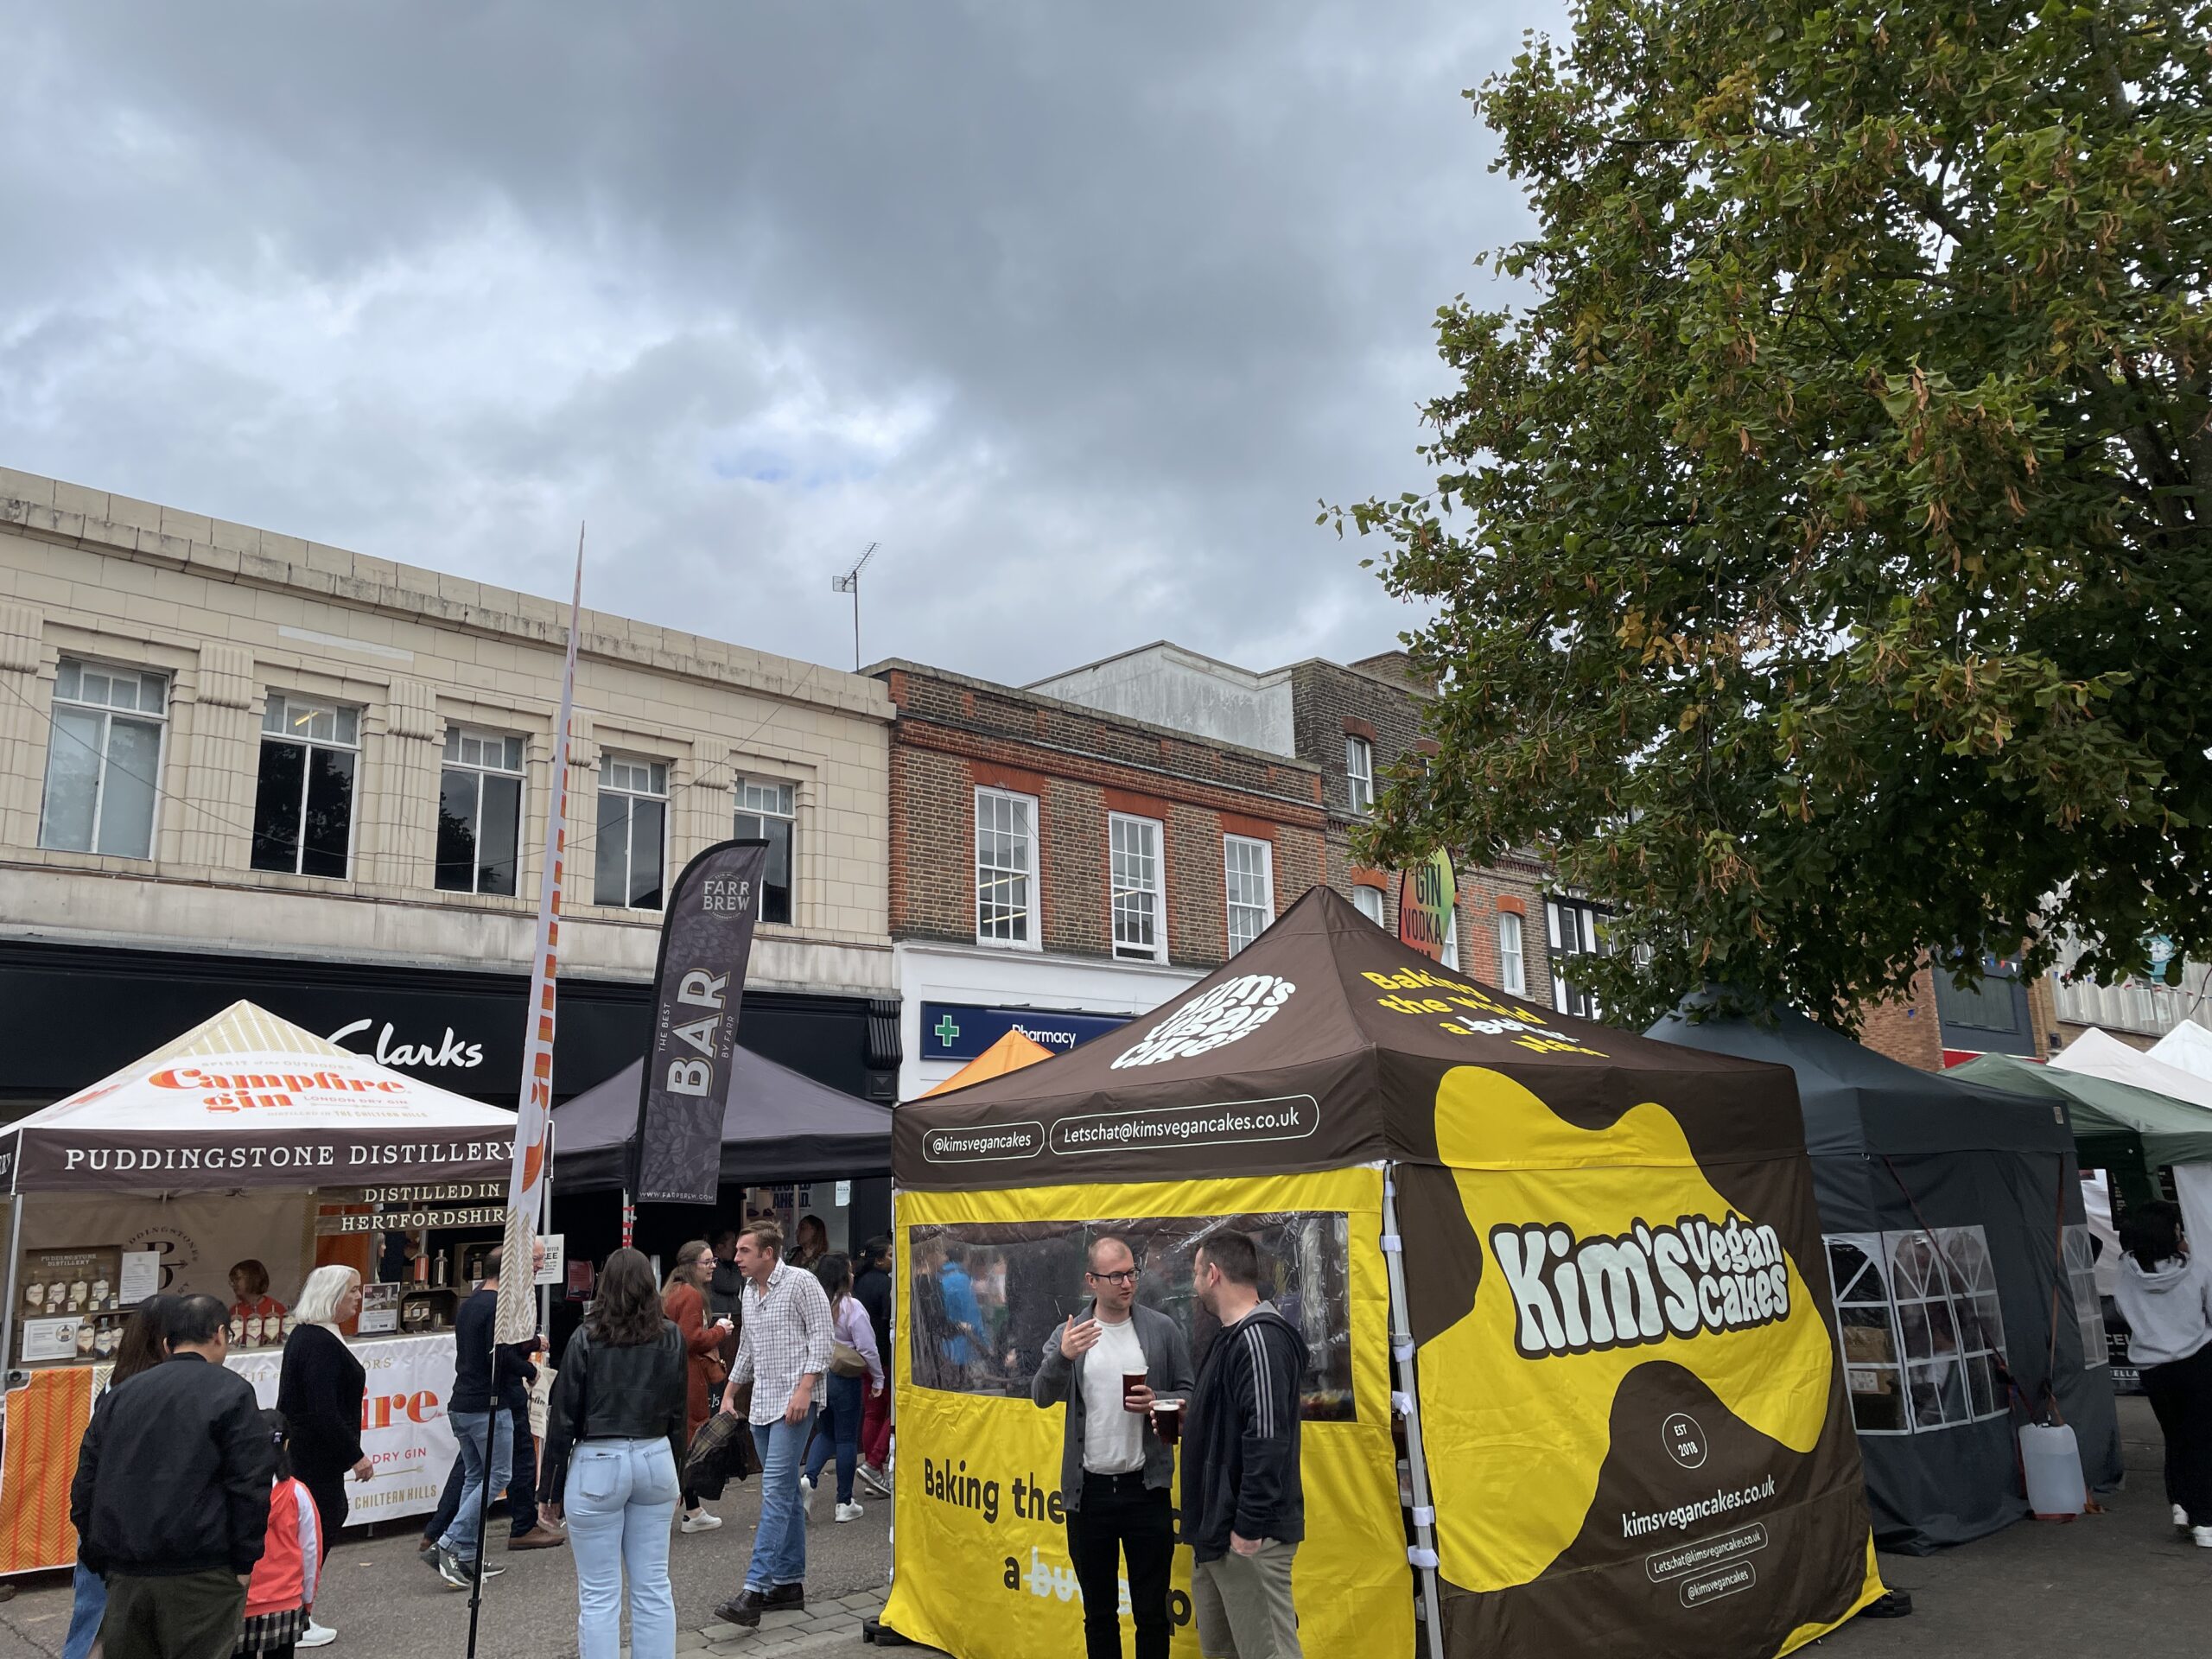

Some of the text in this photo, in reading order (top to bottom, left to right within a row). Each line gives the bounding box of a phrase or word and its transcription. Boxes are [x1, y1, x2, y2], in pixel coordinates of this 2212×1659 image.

[703, 880, 750, 895] FARR
[1415, 864, 1441, 907] GIN
[702, 895, 751, 911] BREW
[1404, 908, 1443, 945] VODKA
[1361, 968, 1491, 1002] Baking
[1377, 995, 1453, 1014] the
[658, 1002, 671, 1052] THE BEST
[666, 968, 730, 1097] BAR
[721, 1015, 734, 1058] BY FARR
[1012, 1024, 1076, 1049] Pharmacy
[1440, 1022, 1474, 1035] a
[325, 1019, 483, 1068] Clarks
[149, 1068, 406, 1093] Campfire
[203, 1090, 293, 1114] gin
[932, 1108, 1300, 1154] @kimsvegancakes Letschat@kimsvegancakes.co.uk
[65, 1141, 516, 1170] PUDDINGSTONE DISTILLERY
[364, 1184, 499, 1203] DISTILLED IN
[772, 1192, 811, 1209] AHED.
[340, 1210, 505, 1231] HERTFORDSHIR
[128, 1226, 199, 1255] DDINGSTONE
[1681, 1217, 1783, 1274] Vegan
[1674, 1424, 1688, 1436] EST
[372, 1447, 427, 1465] DRY GIN
[1678, 1441, 1699, 1457] 2018
[354, 1489, 404, 1510] CHILTERN
[407, 1484, 437, 1501] HILLS
[925, 1458, 1065, 1525] Baking the
[1622, 1474, 1776, 1538] kimsvegancakes.co.uk
[1654, 1530, 1762, 1574] Letschat@kimsvegancakes.co.uk
[1003, 1555, 1020, 1591] a
[1688, 1569, 1750, 1601] @kimsvegancakes
